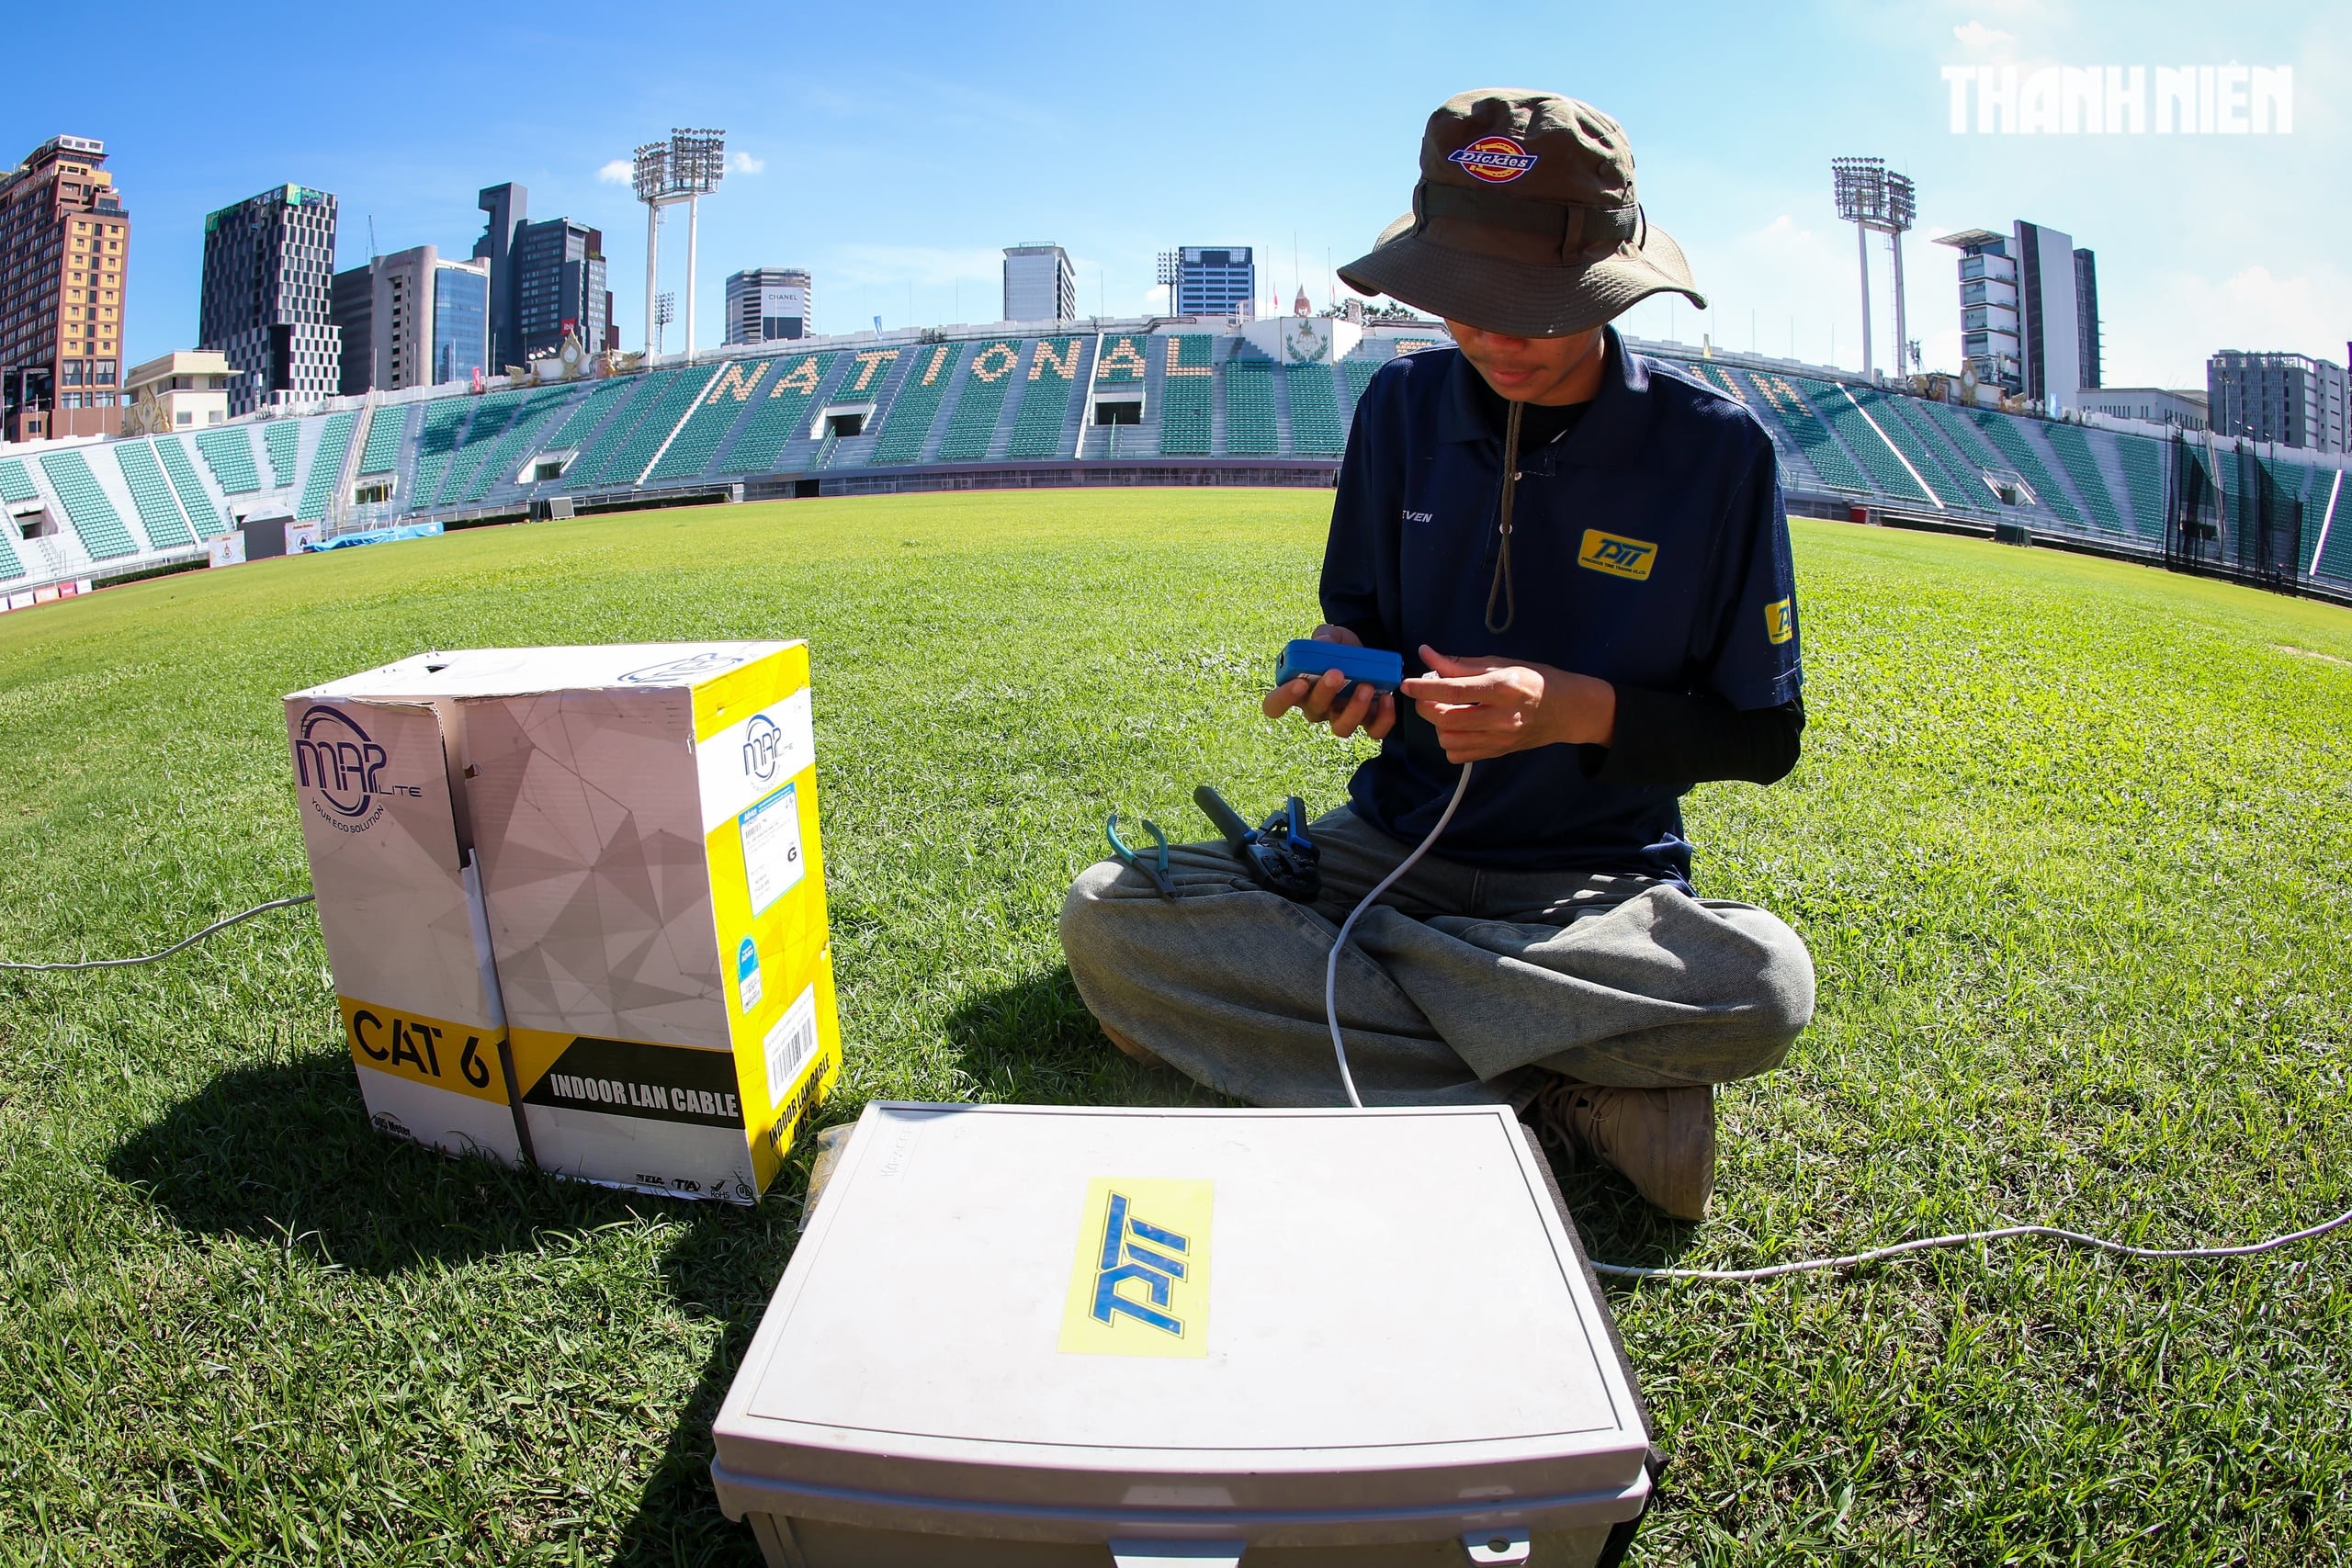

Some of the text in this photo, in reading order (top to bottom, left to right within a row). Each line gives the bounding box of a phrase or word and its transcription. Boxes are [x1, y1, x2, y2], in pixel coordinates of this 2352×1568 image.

[1457, 150, 1529, 170] Dickies
[706, 335, 1212, 405] NATIONAL
[378, 784, 423, 797] LITE
[311, 796, 385, 834] YOUR ECO SOLUTION
[787, 846, 797, 863] G
[353, 1009, 490, 1089] CAT 6
[549, 1073, 739, 1118] INDOOR LAN CABLE
[768, 1098, 797, 1148] INDOOR
[797, 1079, 810, 1111] LAN
[809, 1053, 830, 1091] CABLE
[710, 1190, 730, 1200] RoHS
